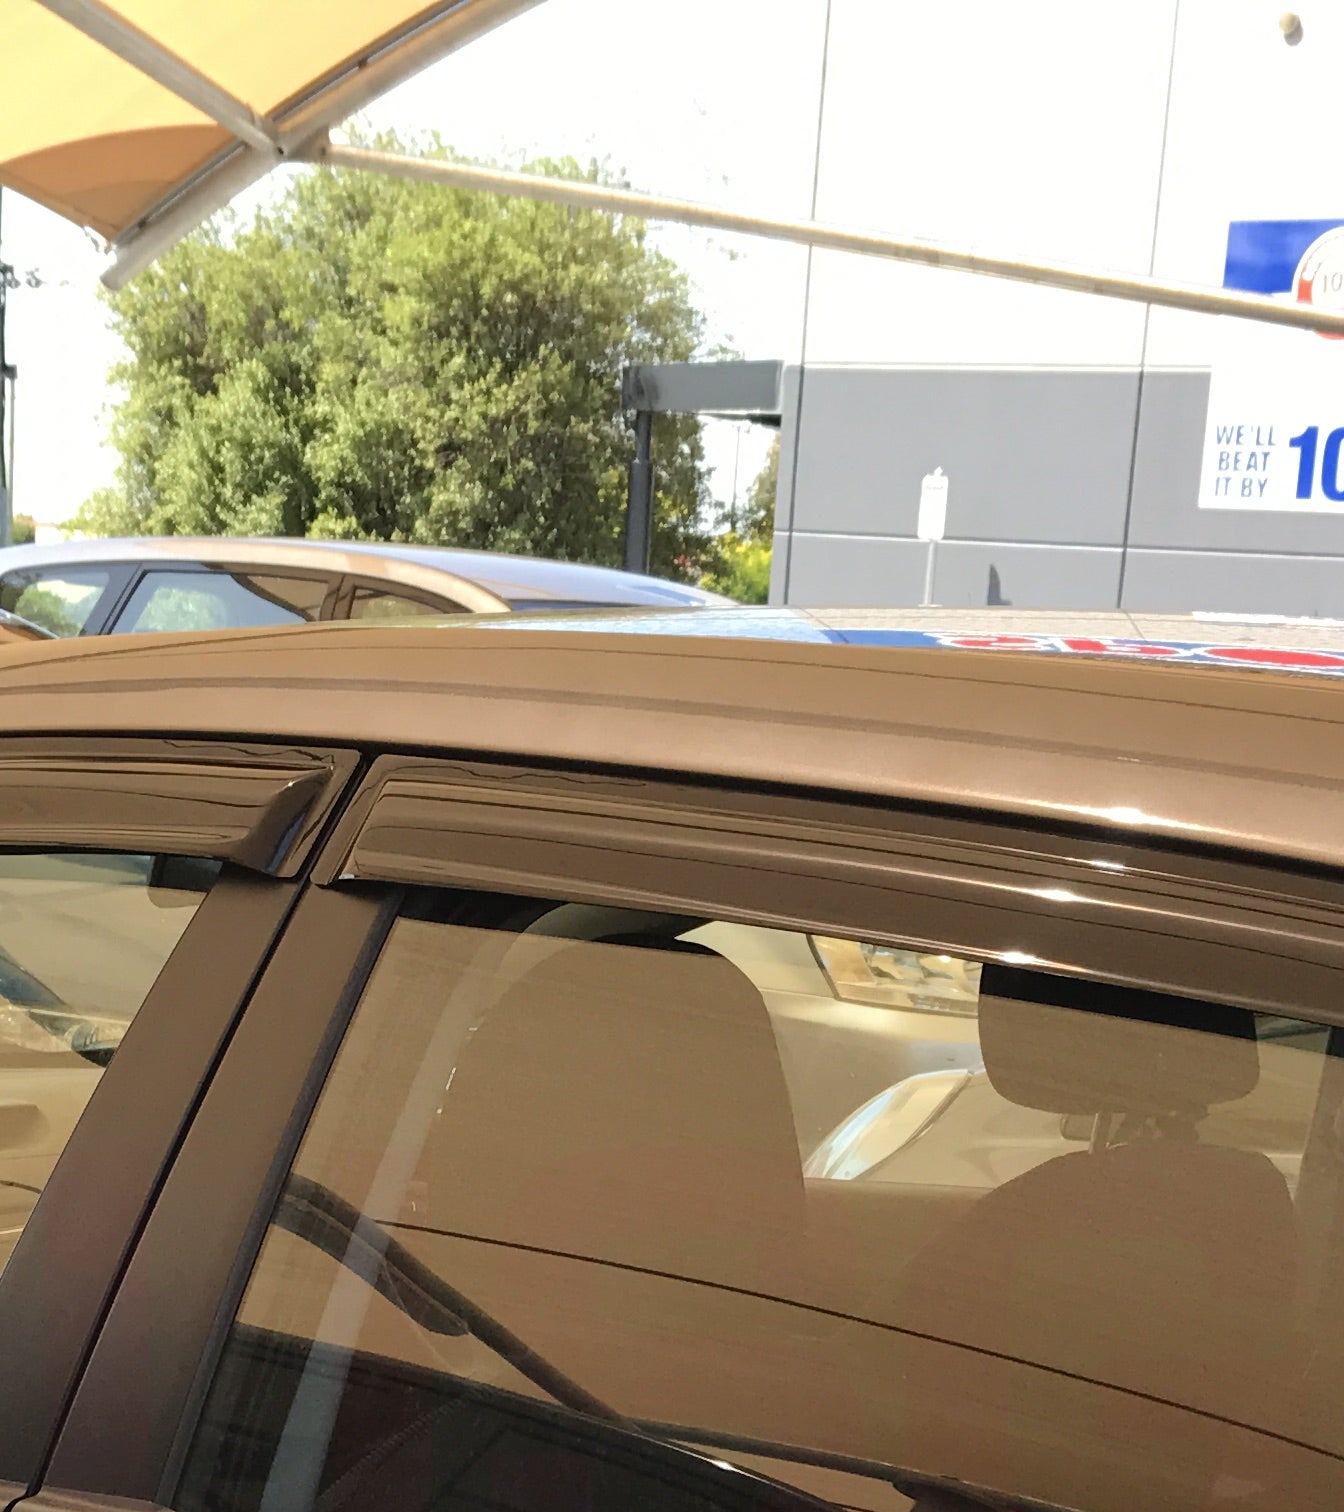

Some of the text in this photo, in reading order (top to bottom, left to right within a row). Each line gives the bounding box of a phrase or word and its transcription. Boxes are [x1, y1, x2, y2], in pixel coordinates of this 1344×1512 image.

[1216, 425, 1277, 446] WE'LL
[1218, 451, 1271, 472] BEAT
[1215, 477, 1268, 498] IT BY
